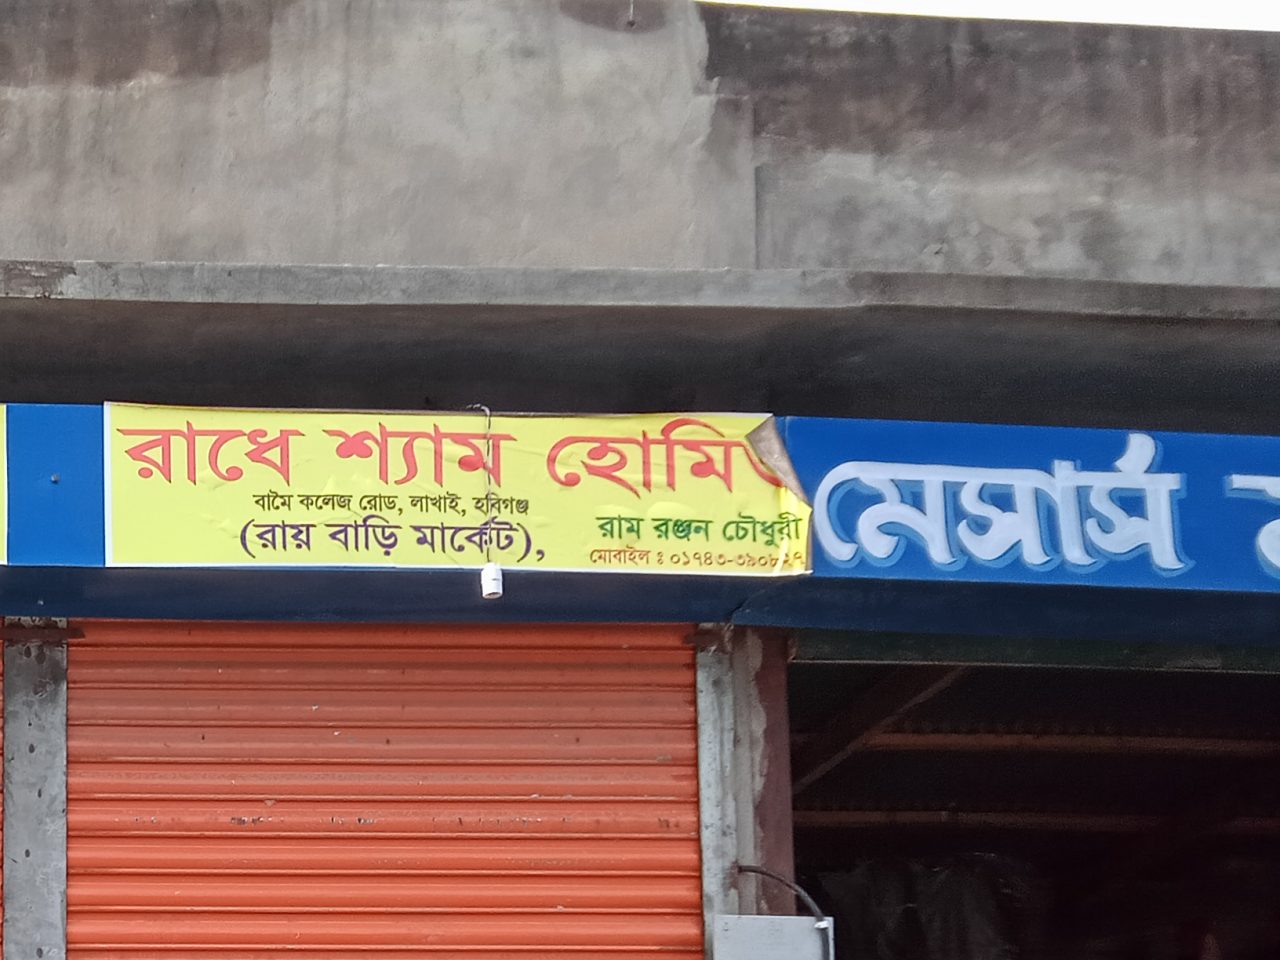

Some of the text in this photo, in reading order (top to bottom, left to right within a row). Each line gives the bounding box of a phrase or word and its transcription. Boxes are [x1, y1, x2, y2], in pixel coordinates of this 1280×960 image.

[116, 420, 306, 487] রাধে
[322, 421, 519, 488] শ্যাম
[252, 489, 294, 512] বামৈ
[297, 493, 354, 512] কলেজ
[358, 493, 403, 516] রোড,
[409, 491, 467, 517] লাখাই,
[814, 433, 1192, 574] মেসার্স
[240, 513, 546, 564] (রায় বাড়ি মার্কেট),
[595, 511, 803, 548] রাম রঞ্জন চৌধুরী
[590, 546, 651, 566] মোবাইল
